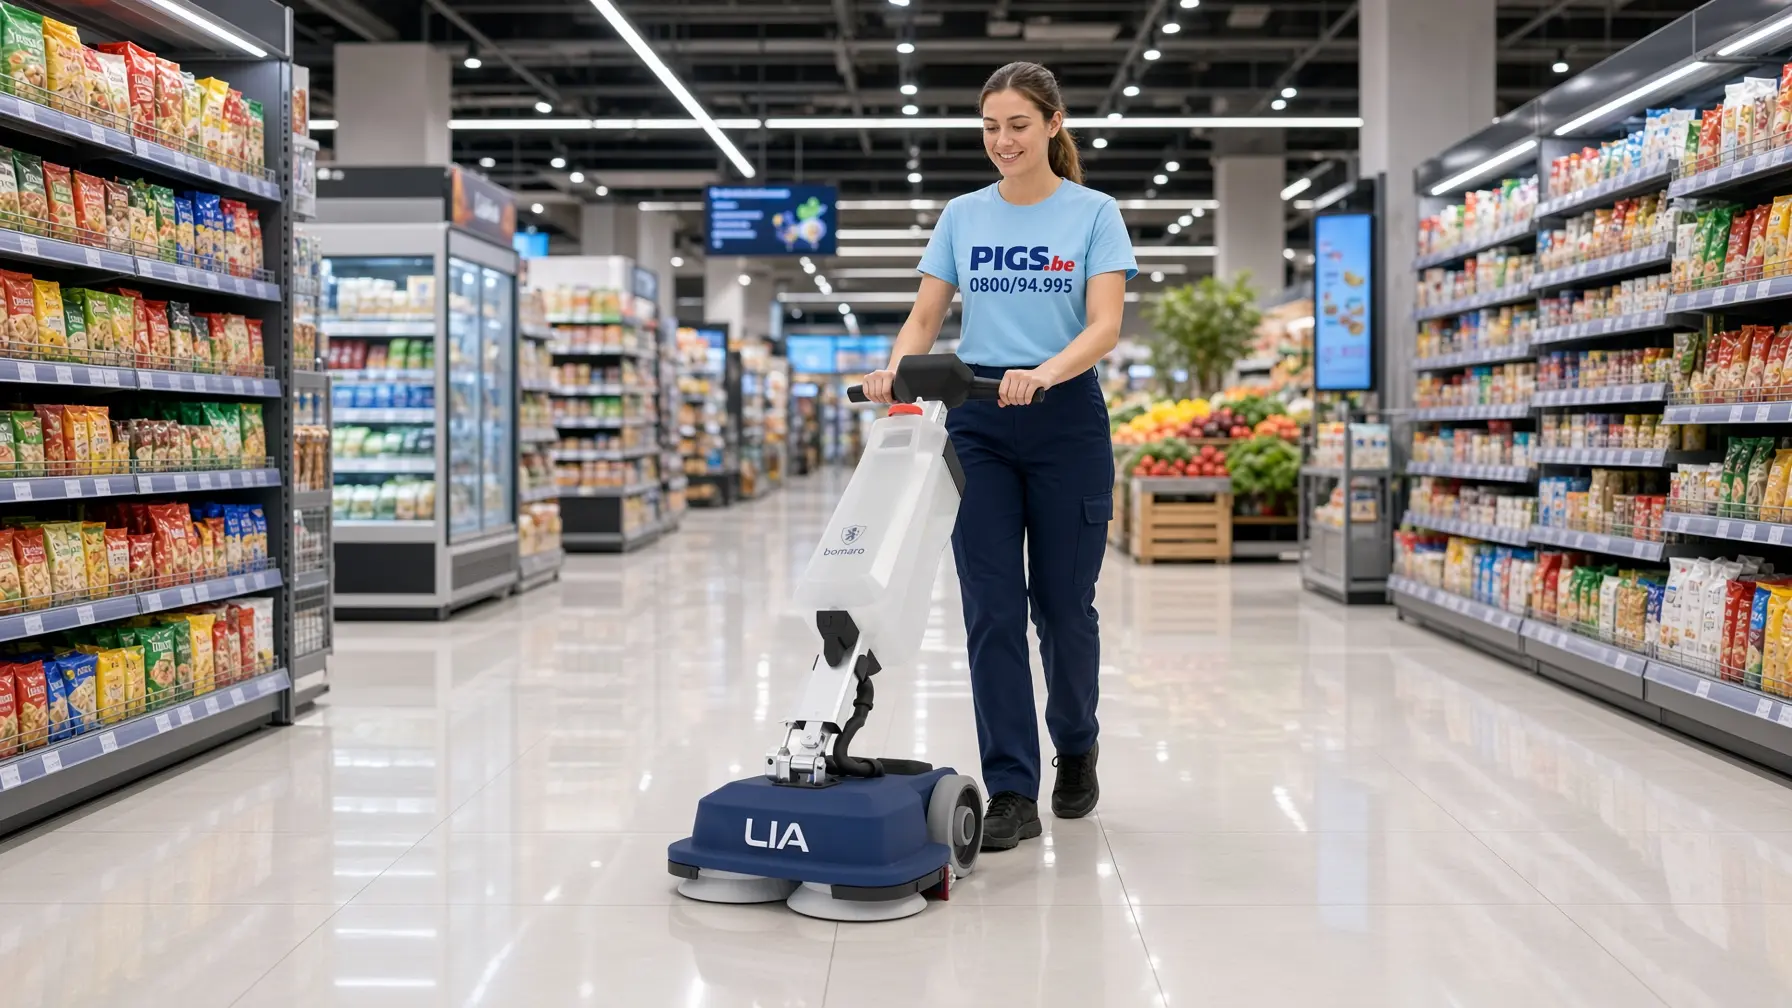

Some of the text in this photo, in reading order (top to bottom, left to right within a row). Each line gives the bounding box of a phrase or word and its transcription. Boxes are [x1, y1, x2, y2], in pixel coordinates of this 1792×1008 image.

[969, 245, 1075, 272] PIGS.be
[969, 276, 1073, 294] 0800/94.995
[823, 547, 865, 556] bomaro
[744, 817, 810, 853] LIA
